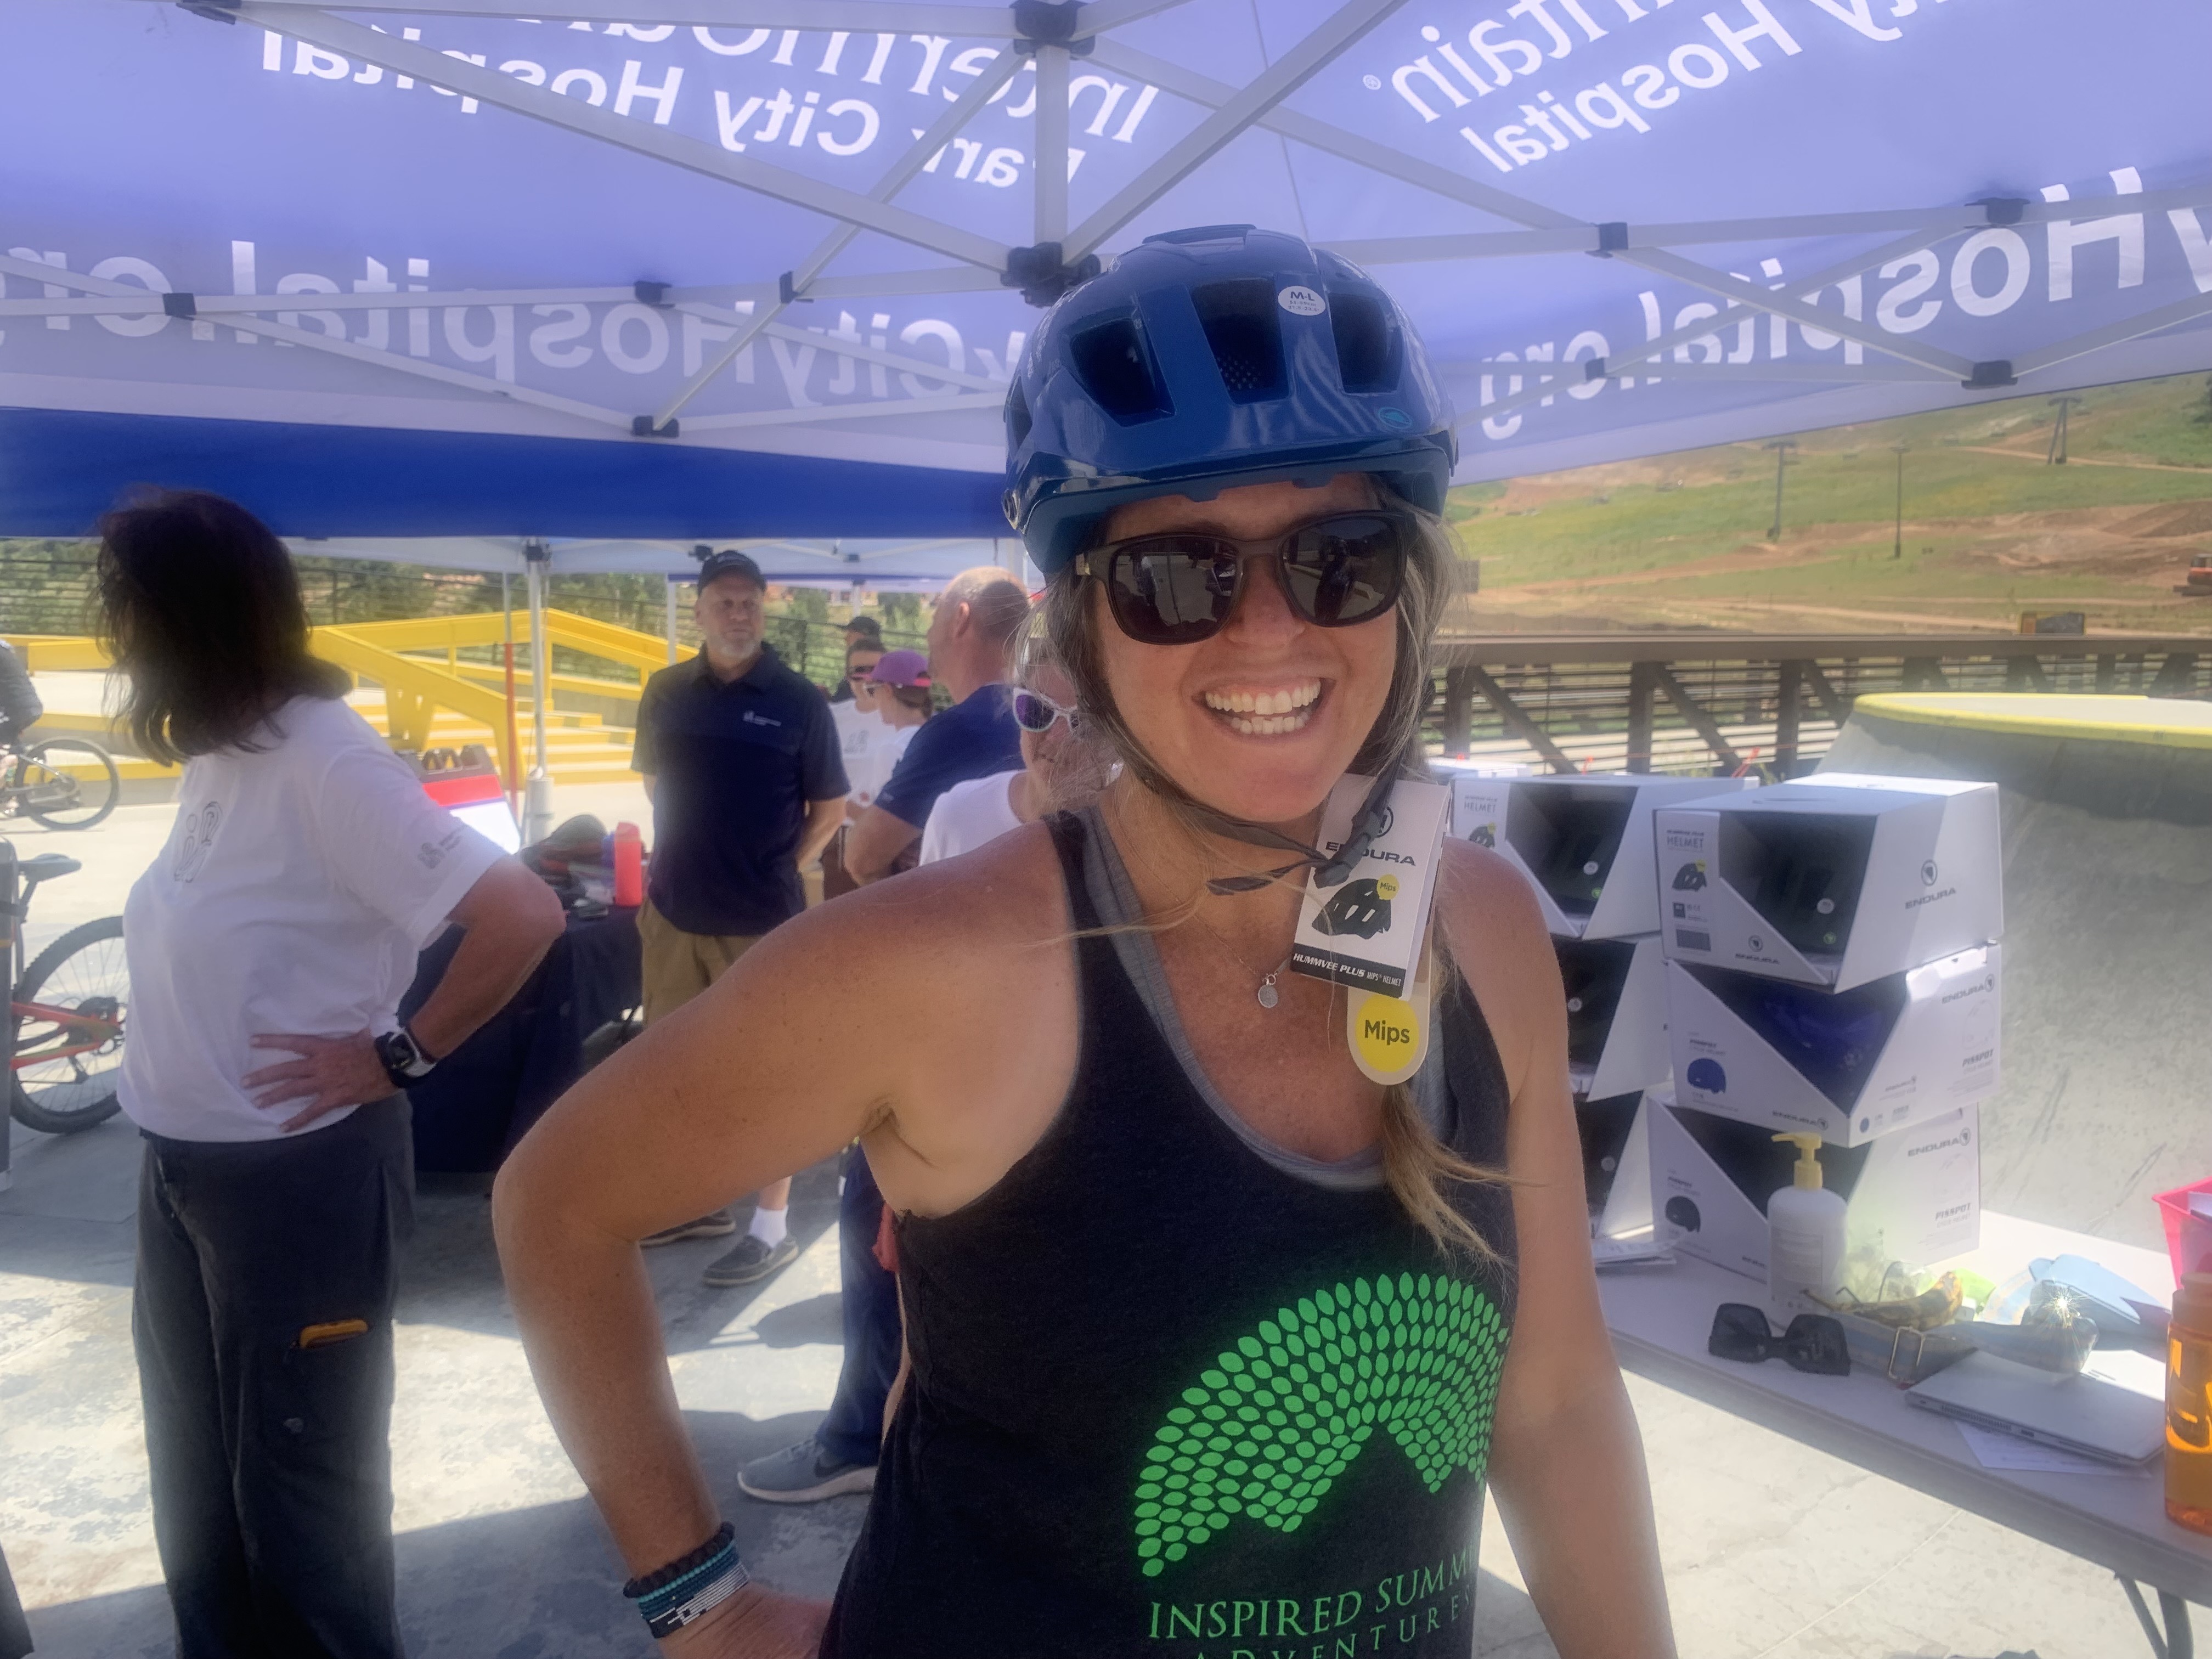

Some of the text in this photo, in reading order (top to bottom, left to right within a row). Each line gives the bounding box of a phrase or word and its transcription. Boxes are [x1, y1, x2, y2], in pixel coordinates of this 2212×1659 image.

[1290, 291, 1315, 301] M-L
[1464, 802, 1497, 813] HELMET
[1325, 841, 1416, 866] EURA
[1667, 836, 1704, 849] HELMET
[1380, 882, 1397, 891] Mips
[1905, 887, 1957, 910] ENDURA
[1293, 953, 1339, 971] HUMMVEE
[1339, 964, 1366, 977] PLUS
[1383, 975, 1402, 987] HELMET
[1942, 983, 1985, 1005] ENDURA
[1364, 1019, 1410, 1046] Mips
[1908, 1137, 1960, 1157] ENDURA
[1149, 1544, 1477, 1639] INSPIRED SUMMI
[1196, 1584, 1470, 1659] ENTURES
